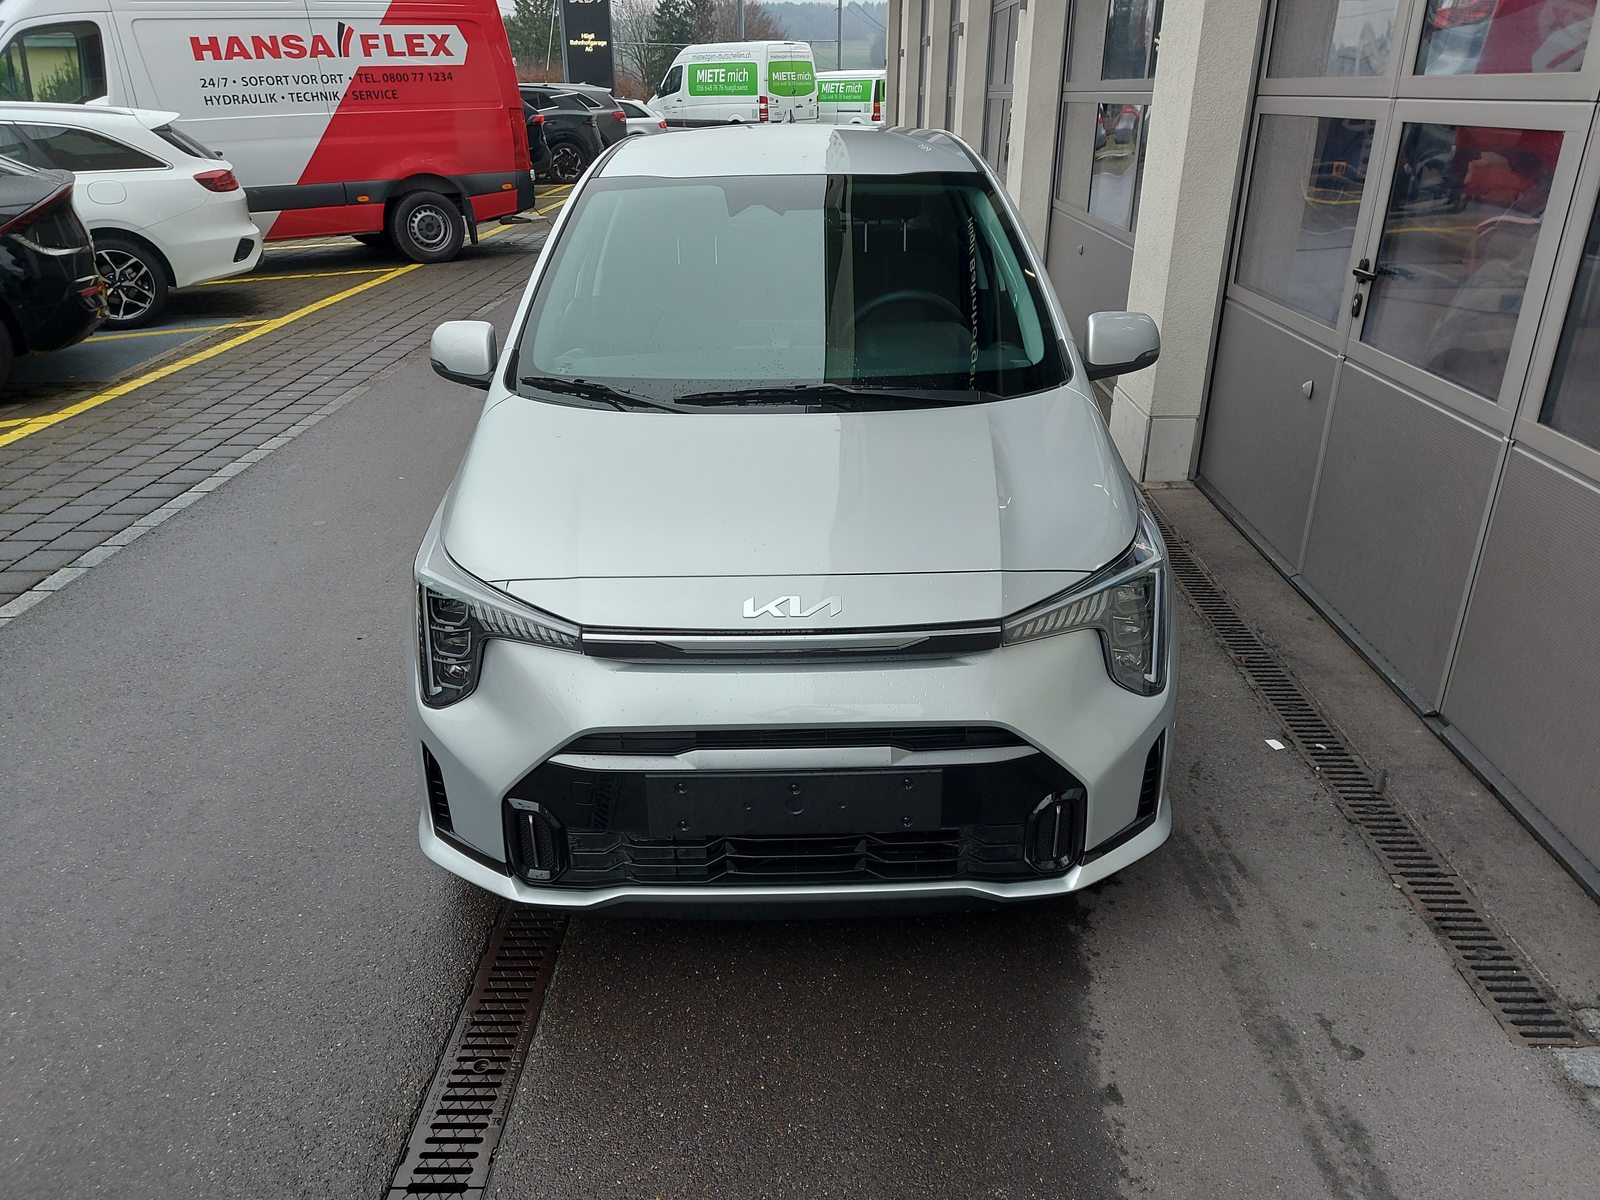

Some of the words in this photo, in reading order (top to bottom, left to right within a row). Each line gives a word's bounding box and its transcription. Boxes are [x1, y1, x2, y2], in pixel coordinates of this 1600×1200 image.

[189, 34, 335, 61] HANSA
[359, 33, 455, 57] FLEX
[569, 39, 607, 47] Bahnhofgarage
[200, 77, 229, 89] 24/7
[241, 75, 292, 87] SOFORT
[292, 74, 319, 86] VOR
[320, 73, 344, 85] ORT
[357, 73, 380, 84] TEL.
[382, 72, 410, 83] 0800
[411, 72, 426, 82] 77
[427, 71, 454, 82] 1234
[696, 68, 726, 83] MIETE
[727, 67, 749, 82] mich
[772, 71, 796, 81] MIETE
[797, 71, 812, 80] mich
[821, 82, 845, 93] MIETE
[845, 82, 863, 93] mich
[204, 93, 278, 106] HYDRAULIK
[288, 91, 341, 103] TECHNIK
[351, 89, 398, 101] SERVICE
[743, 595, 842, 618] KIA
